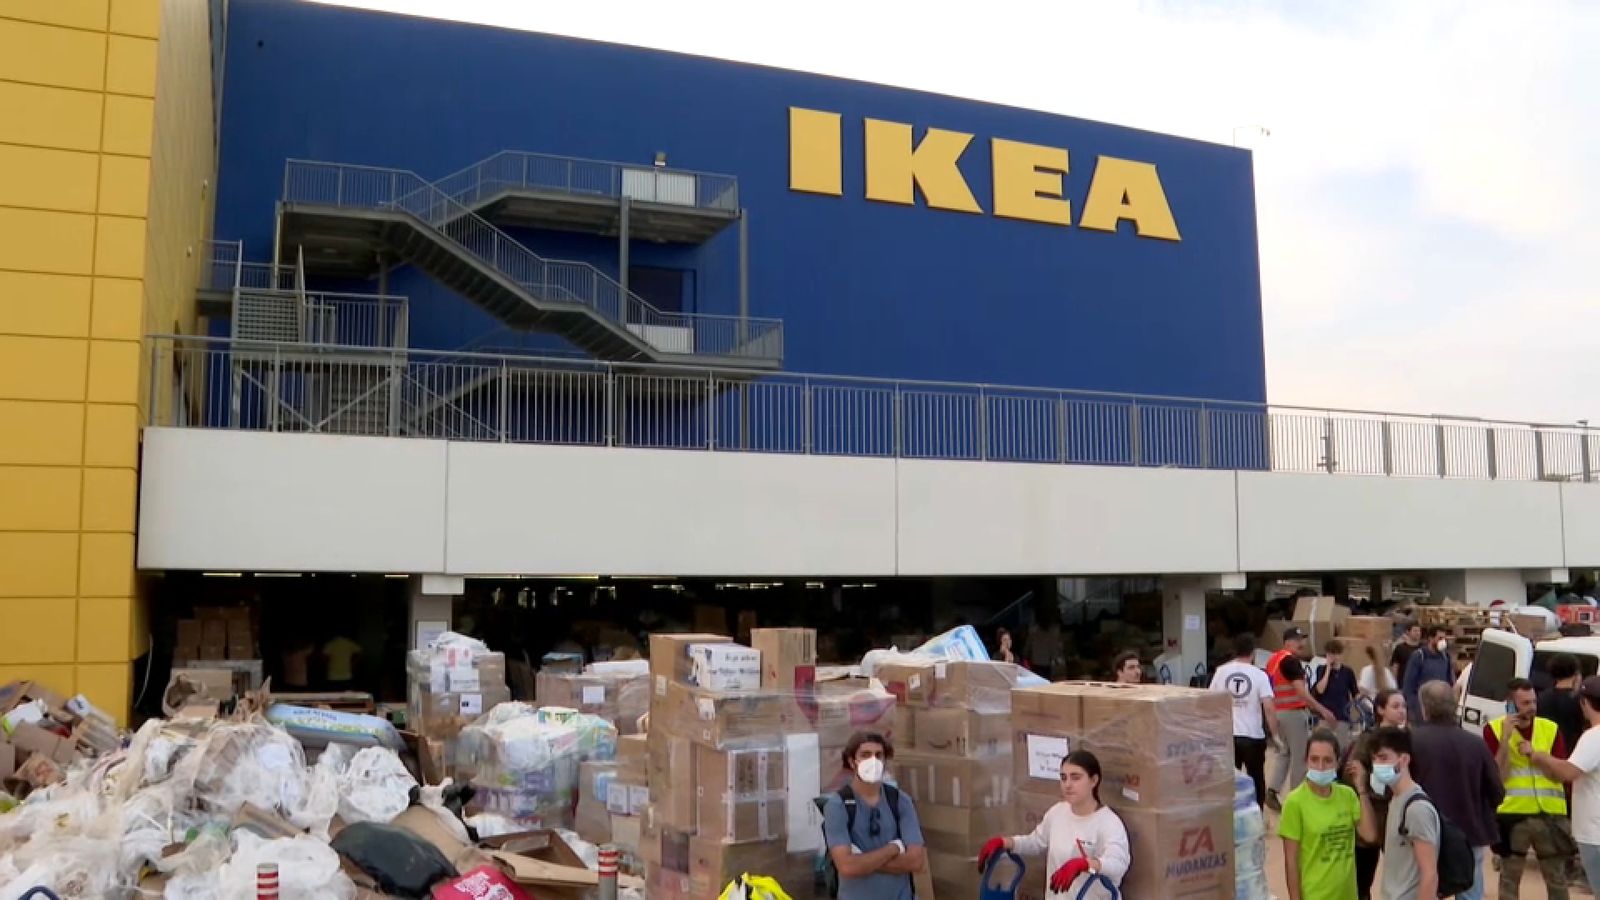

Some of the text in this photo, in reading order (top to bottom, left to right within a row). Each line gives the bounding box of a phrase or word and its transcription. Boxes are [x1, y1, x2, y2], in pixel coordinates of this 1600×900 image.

[789, 106, 1181, 241] IKEA
[1233, 678, 1243, 693] T
[1166, 852, 1227, 878] MUDANZAS
